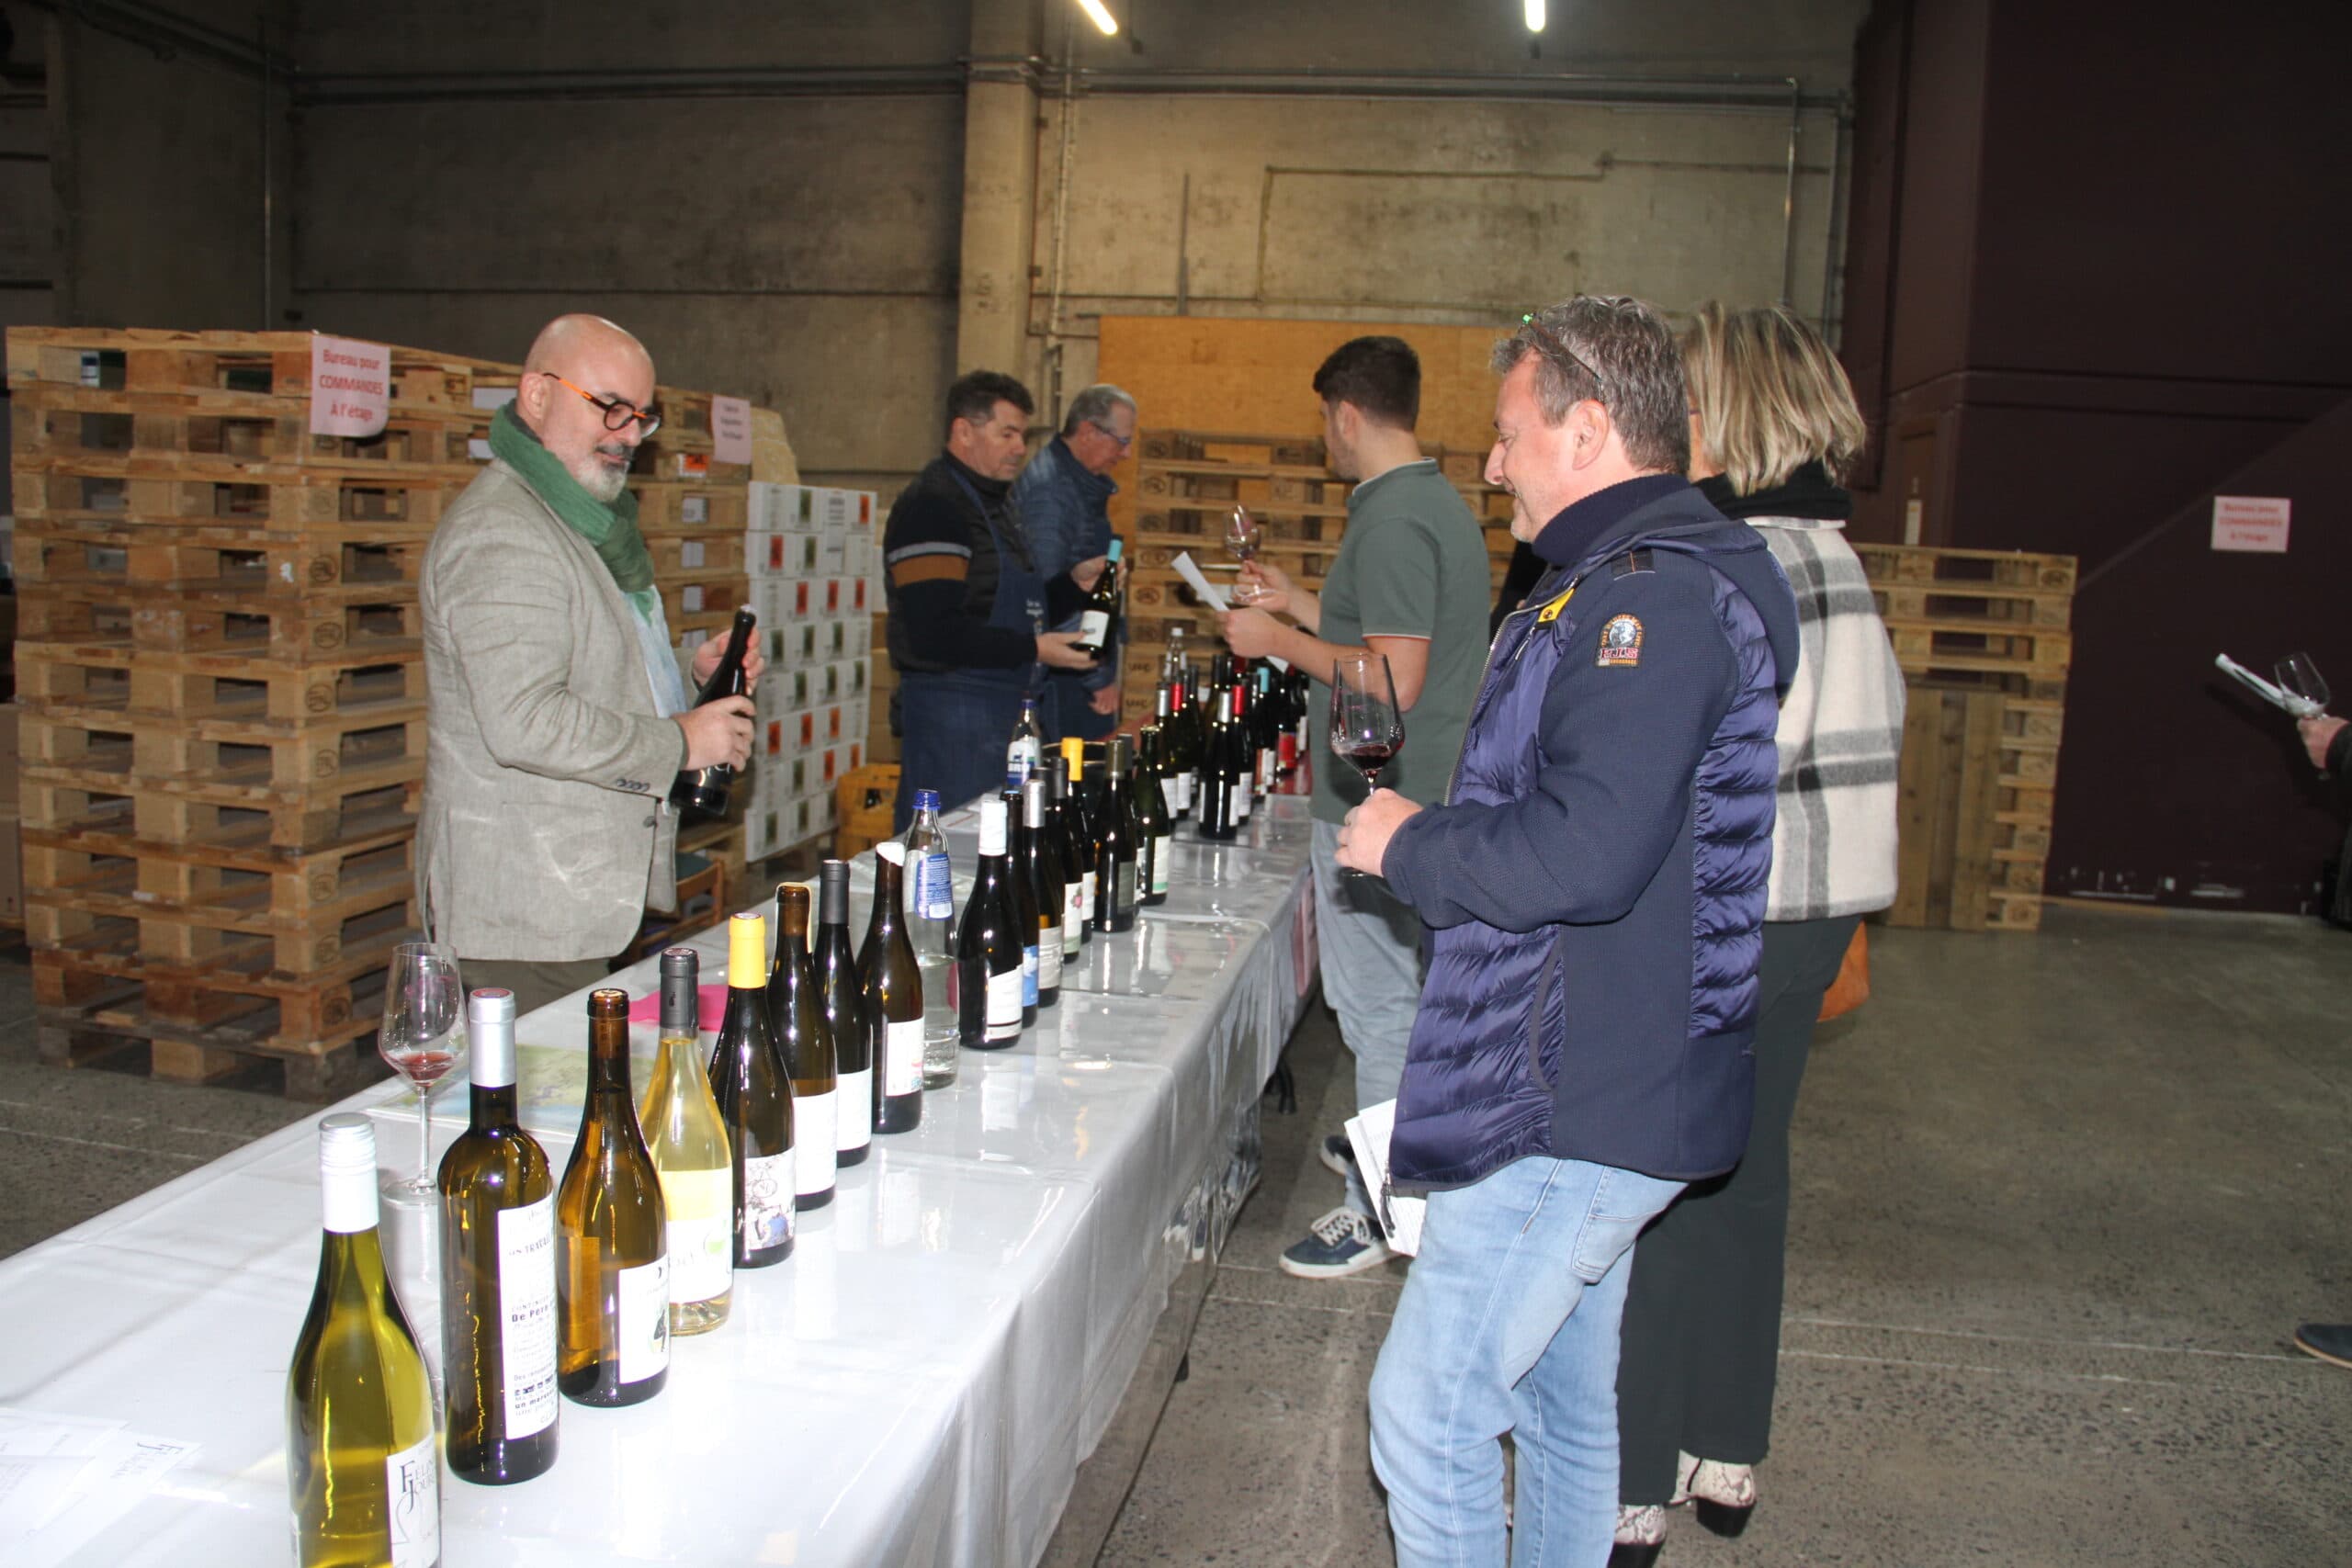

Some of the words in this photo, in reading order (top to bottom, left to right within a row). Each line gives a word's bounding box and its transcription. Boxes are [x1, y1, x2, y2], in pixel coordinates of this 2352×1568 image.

[322, 349, 357, 367] Bureau
[359, 356, 381, 370] pour
[319, 374, 384, 396] COMMANDES
